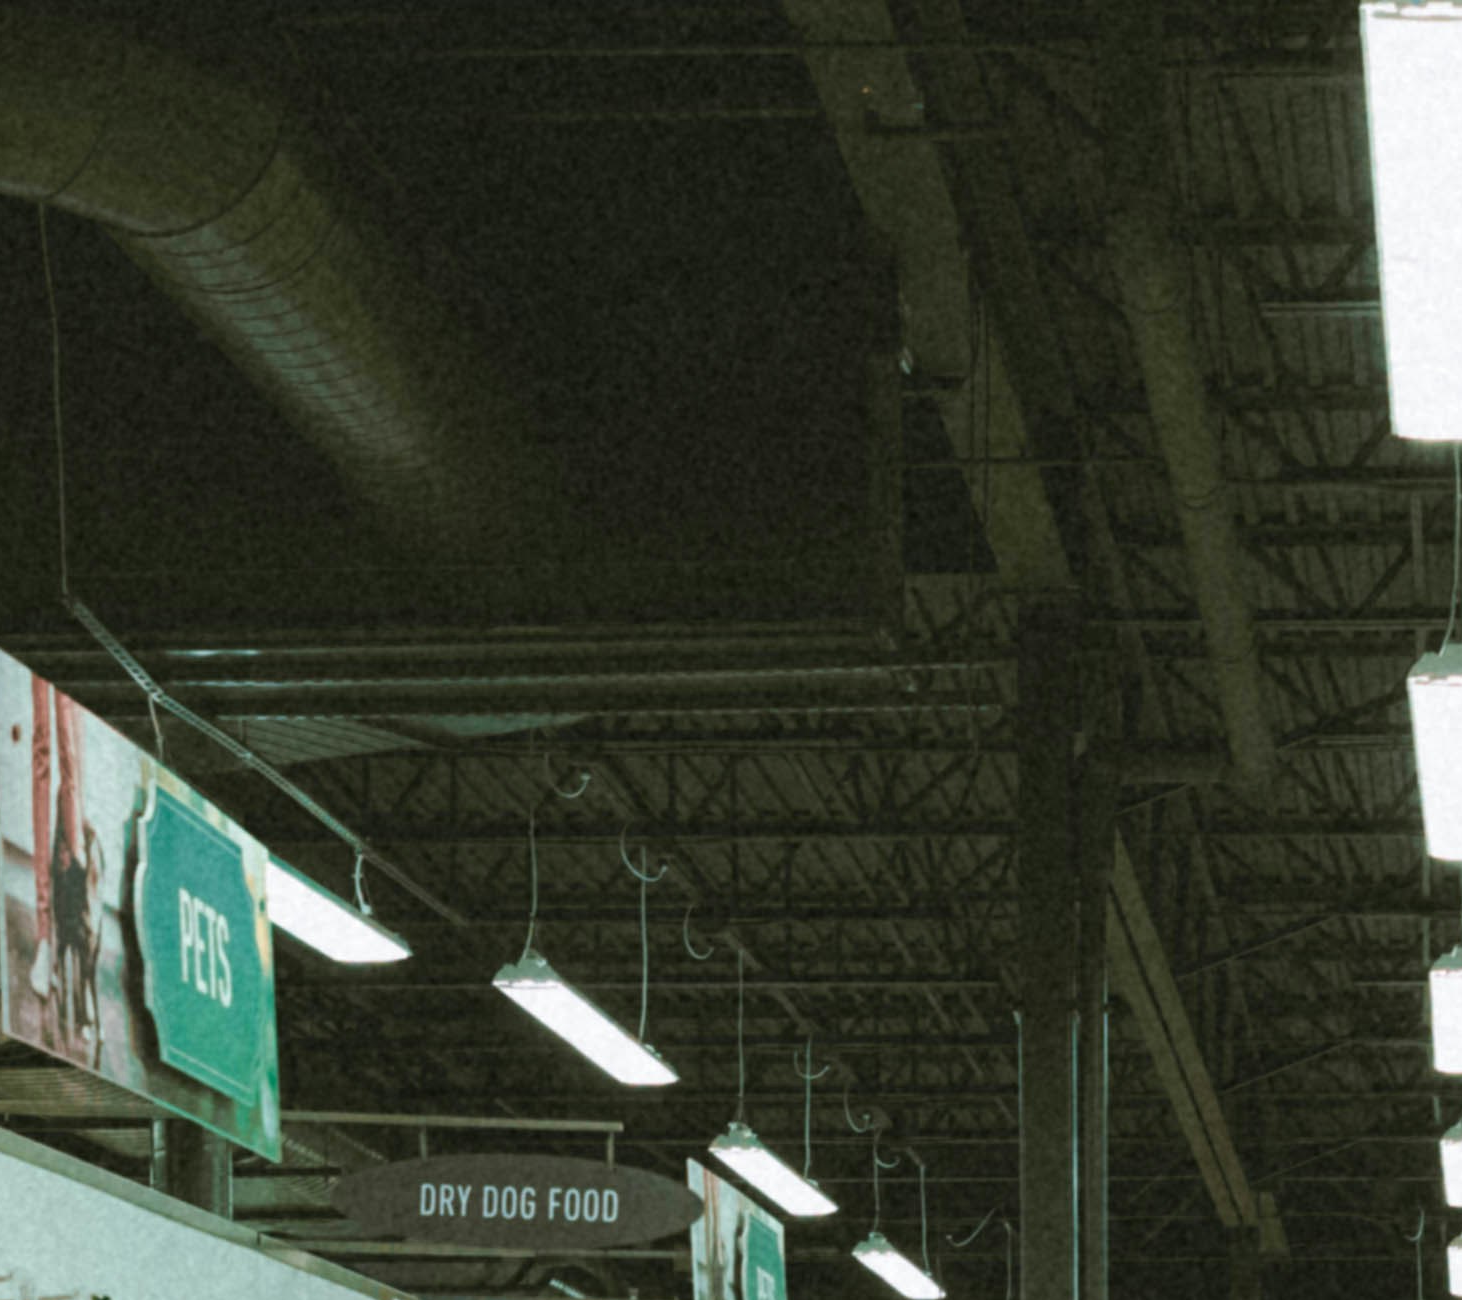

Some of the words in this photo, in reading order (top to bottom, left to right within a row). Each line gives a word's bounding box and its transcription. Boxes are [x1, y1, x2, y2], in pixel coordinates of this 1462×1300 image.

[178, 887, 233, 1008] PETS
[419, 1183, 472, 1217] DRY
[482, 1186, 537, 1220] DOG
[548, 1188, 619, 1223] FOOD
